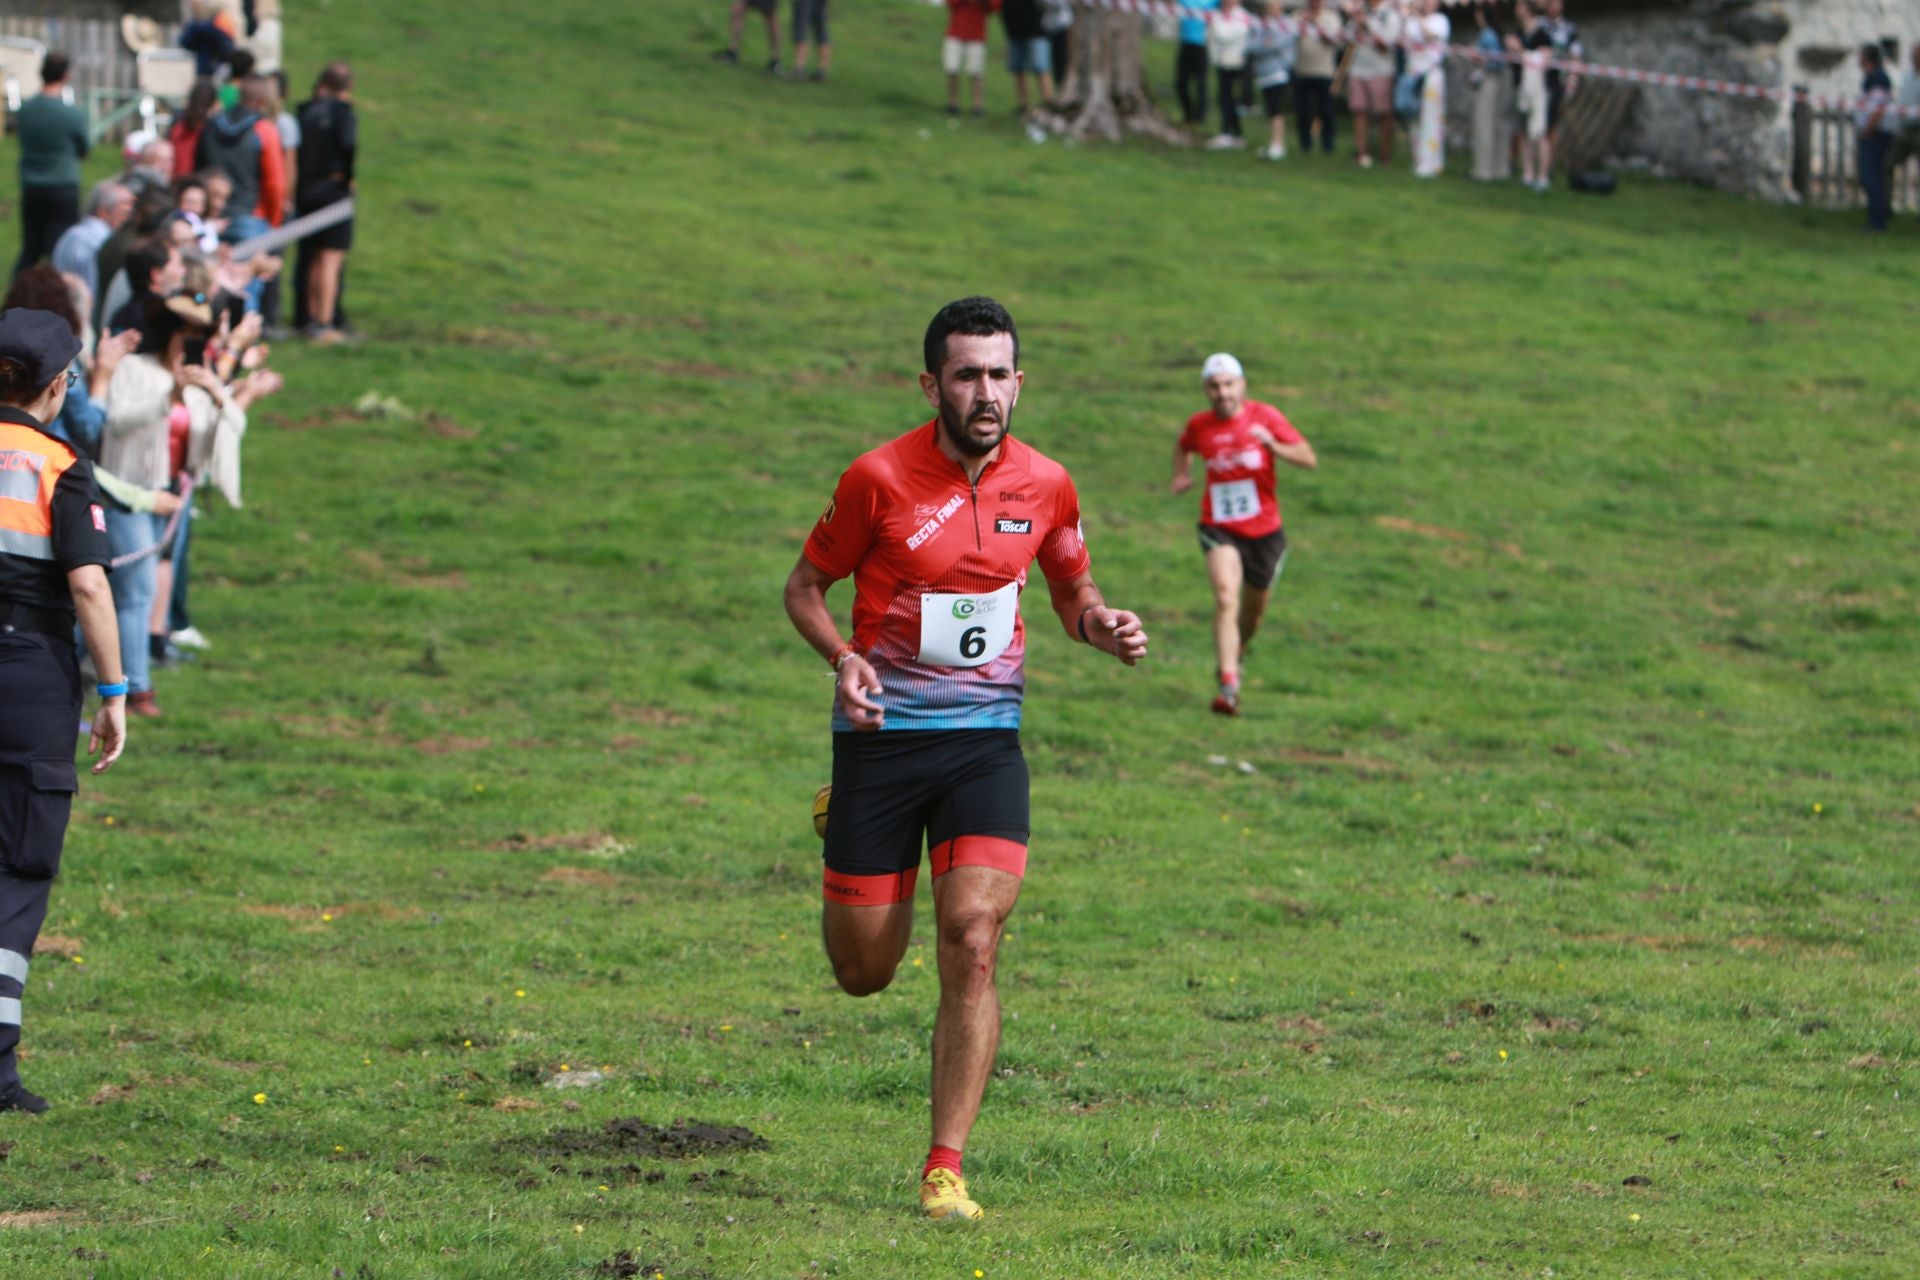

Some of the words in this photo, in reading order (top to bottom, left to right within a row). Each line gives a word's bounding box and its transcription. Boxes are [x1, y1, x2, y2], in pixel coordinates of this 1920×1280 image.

[905, 518, 940, 551] RECTA
[936, 494, 965, 524] FINAL
[997, 520, 1030, 533] Toscaf
[959, 626, 987, 659] 6
